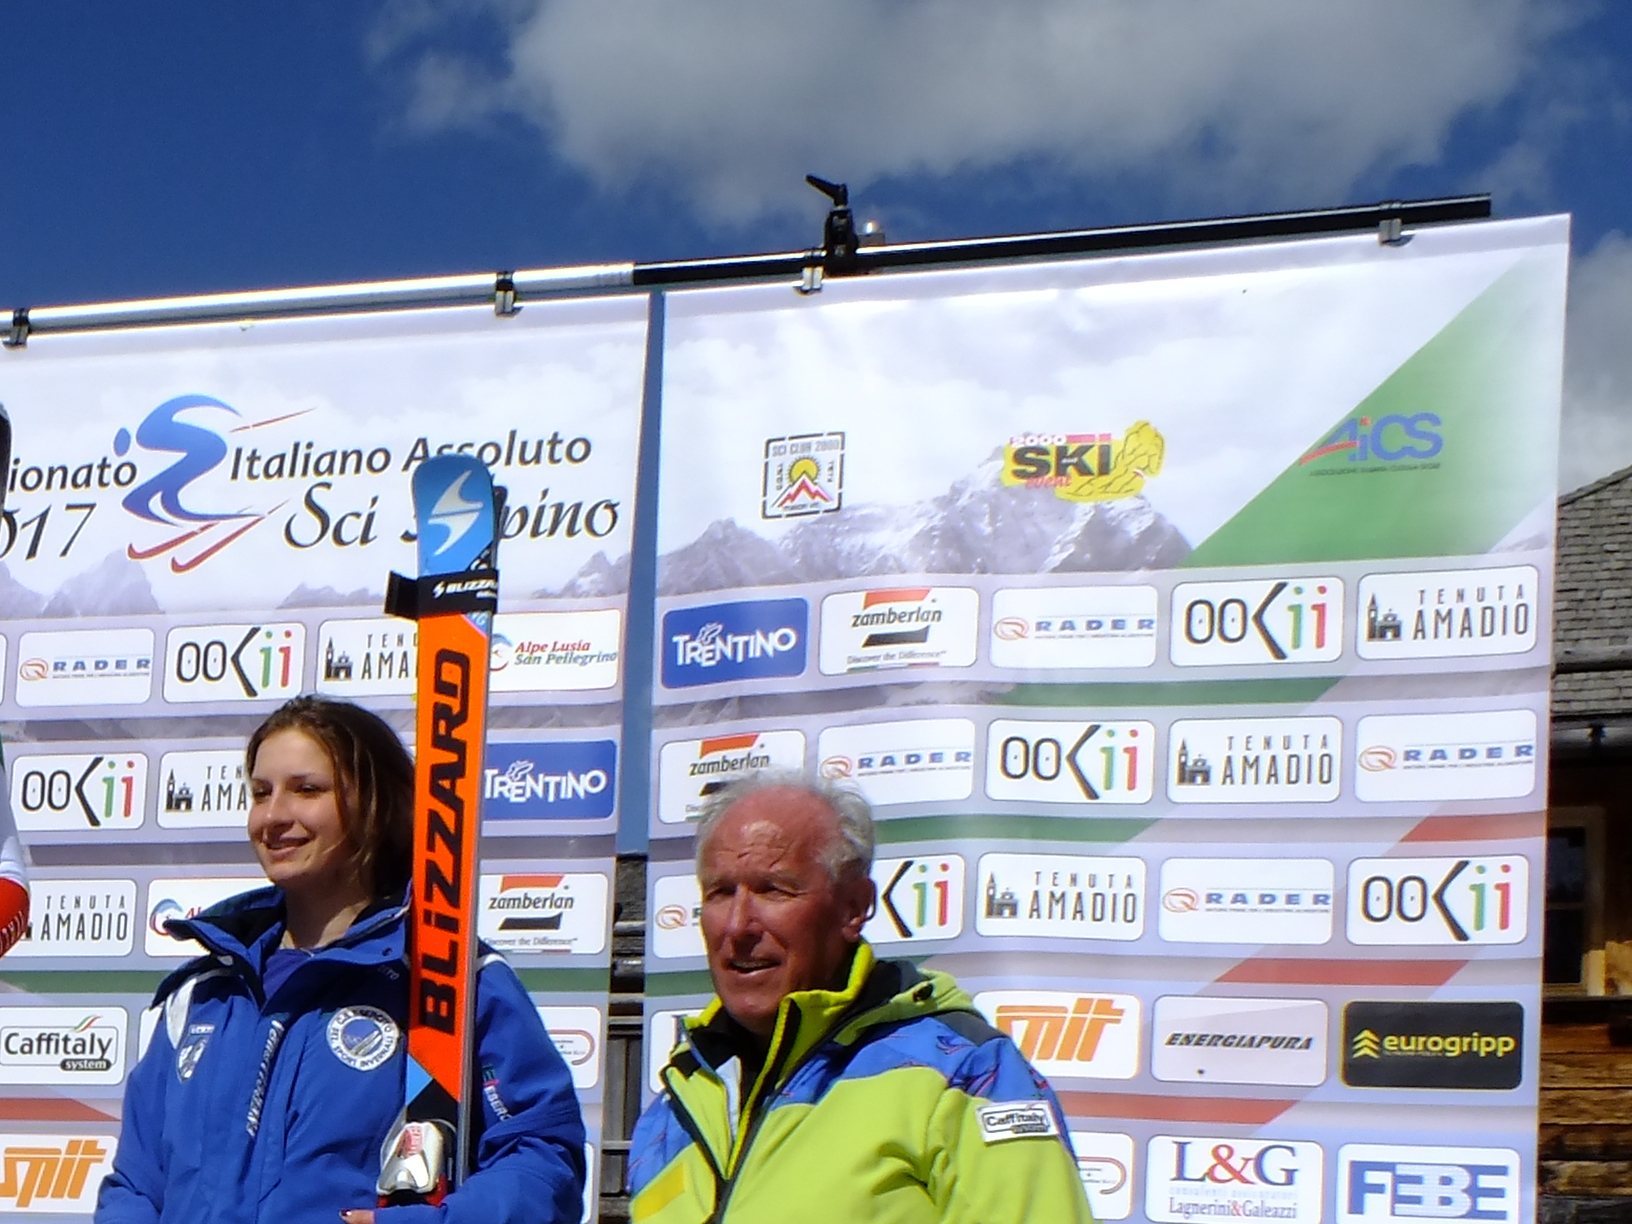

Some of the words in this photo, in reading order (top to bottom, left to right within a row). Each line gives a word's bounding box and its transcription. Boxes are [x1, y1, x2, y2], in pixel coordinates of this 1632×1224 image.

[230, 442, 391, 481] Italiano
[1012, 445, 1112, 480] SKI
[285, 482, 379, 548] Sci
[1419, 585, 1523, 604] TENUTA
[851, 607, 942, 628] zamberlan
[1035, 618, 1155, 631] RADER
[1413, 603, 1528, 640] AMADIO
[514, 641, 548, 653] Alpe
[552, 640, 591, 652] Lusia
[672, 627, 797, 667] TRENTINO
[53, 658, 150, 672] RADER
[514, 654, 542, 666] San
[544, 651, 617, 666] Pellegrino
[1227, 735, 1328, 750] TENUTA
[1403, 745, 1533, 761] RADER
[689, 752, 770, 776] zamberlan
[858, 751, 972, 769] RADER
[1221, 752, 1333, 786] AMADIO
[484, 768, 608, 802] TRENTINO
[1035, 871, 1133, 889] TENUTA
[46, 895, 125, 910] TENUTA
[488, 892, 575, 910] zamberlan
[1028, 889, 1136, 924] AMADIO
[1205, 892, 1331, 905] RADER
[40, 912, 128, 941] AMADIO
[4, 1030, 113, 1059] Caffitaly
[1165, 1031, 1315, 1051] ENERGIAPURA
[1383, 1032, 1516, 1058] eurogripp
[65, 1059, 107, 1071] system
[1169, 1140, 1299, 1187] L&G
[1347, 1159, 1509, 1220] FEBE
